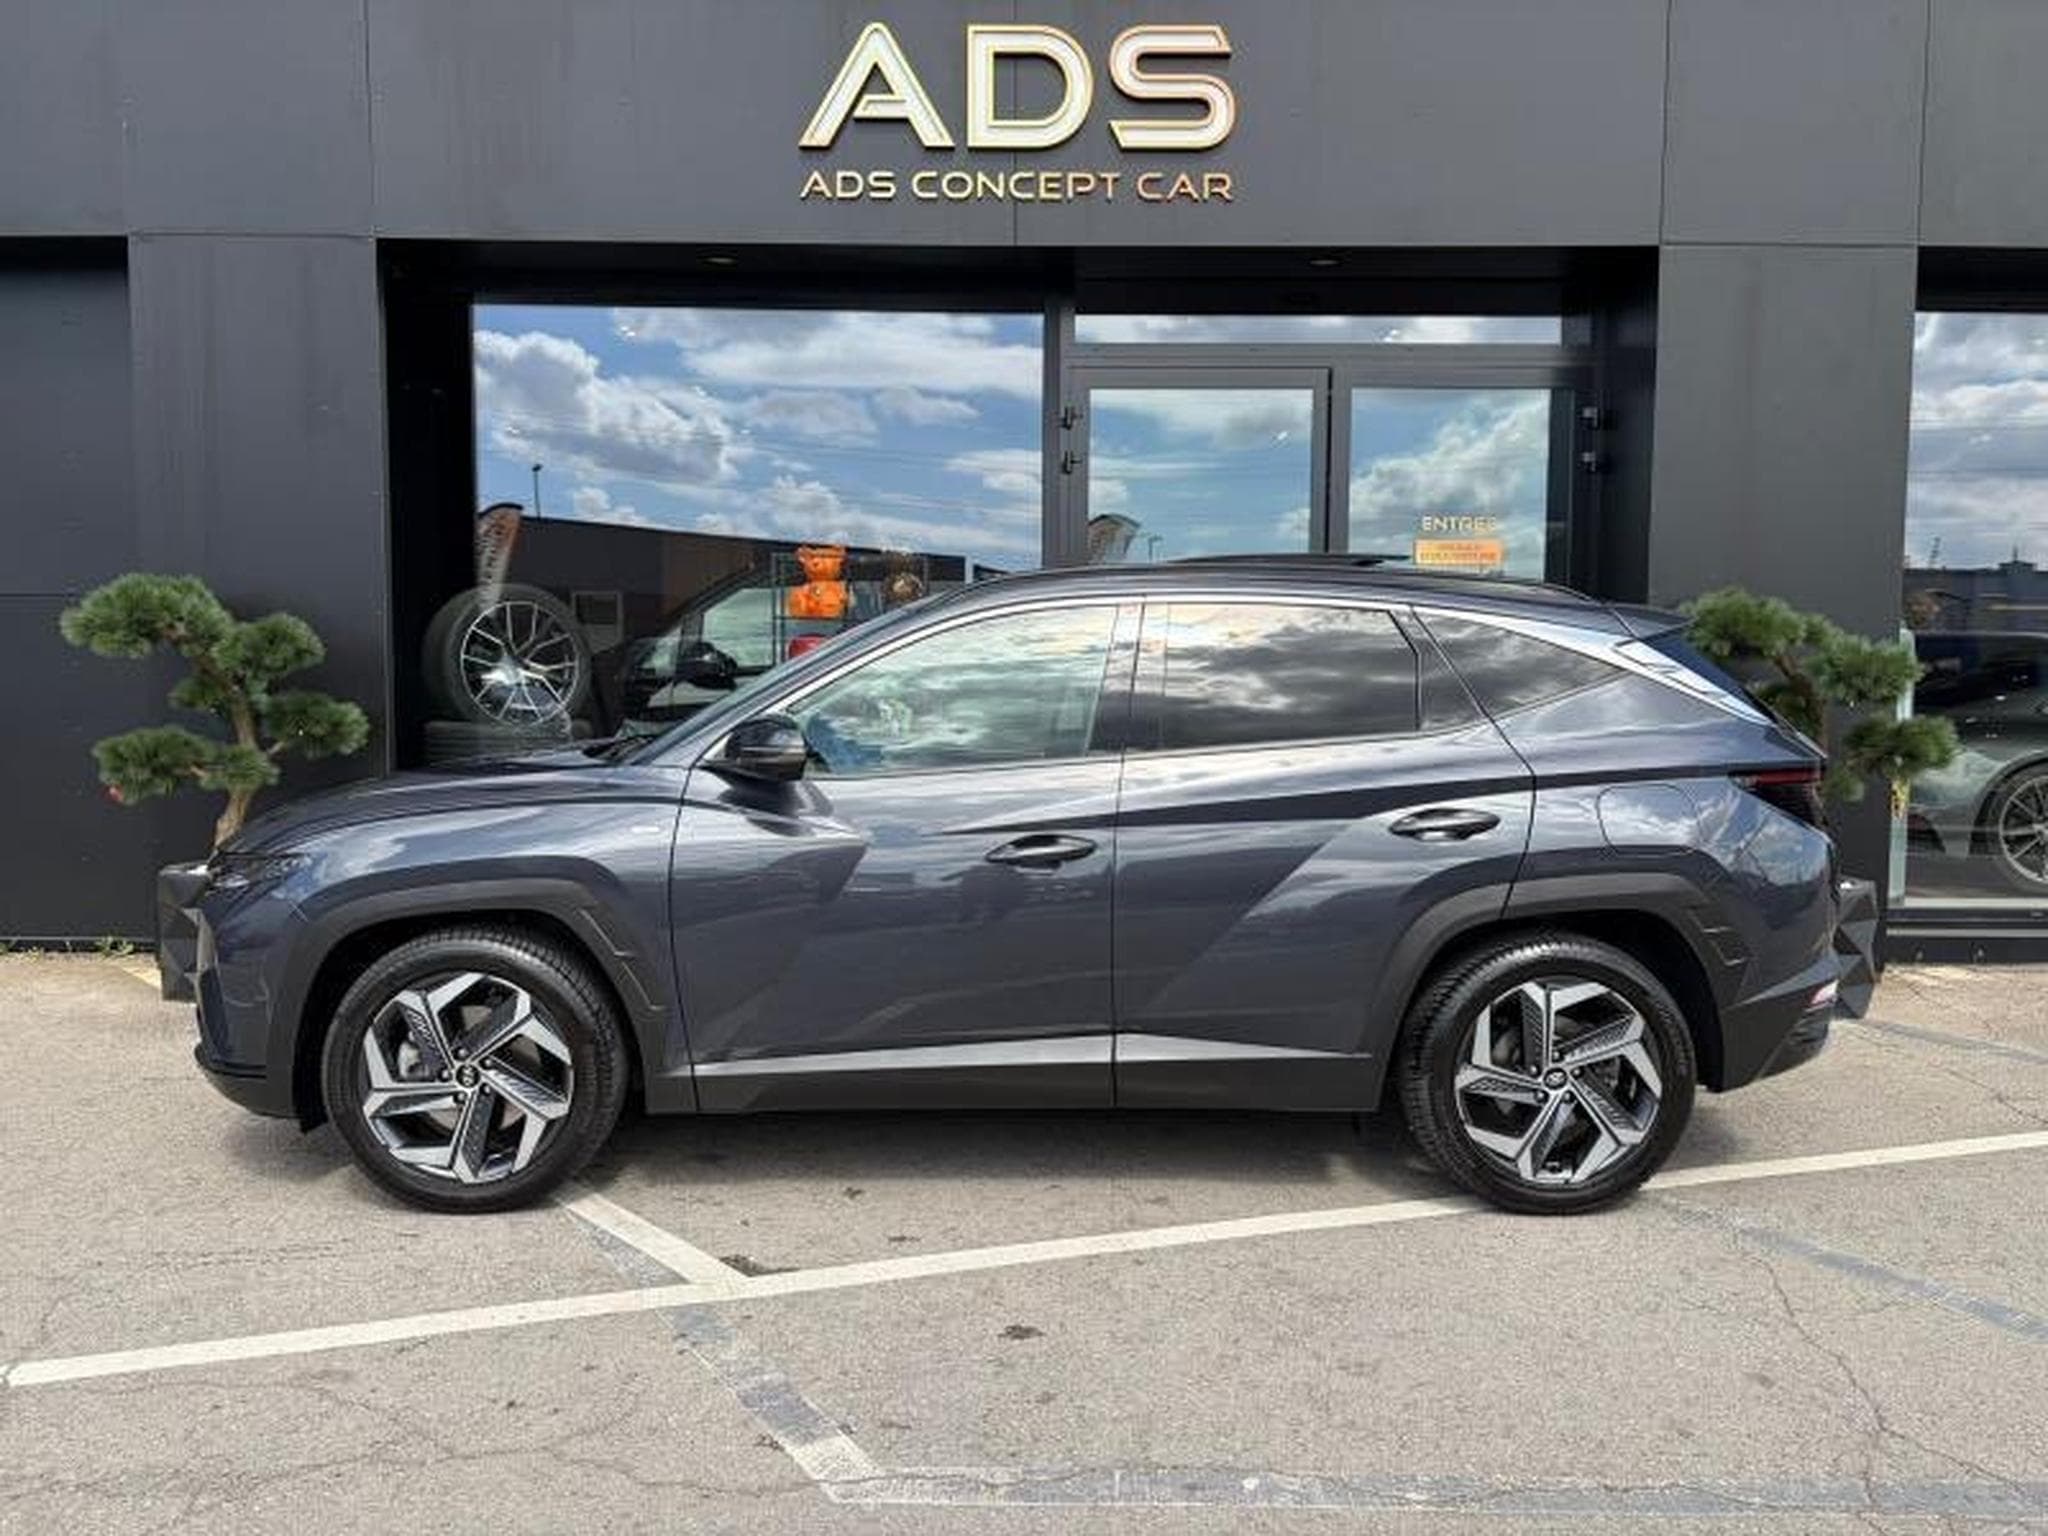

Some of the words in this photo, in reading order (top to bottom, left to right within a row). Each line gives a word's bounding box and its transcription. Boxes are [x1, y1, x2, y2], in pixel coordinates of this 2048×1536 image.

[799, 21, 1236, 149] ADS
[800, 171, 896, 200] ADS
[912, 171, 1119, 201] CONCEPT
[1137, 172, 1233, 201] CAR
